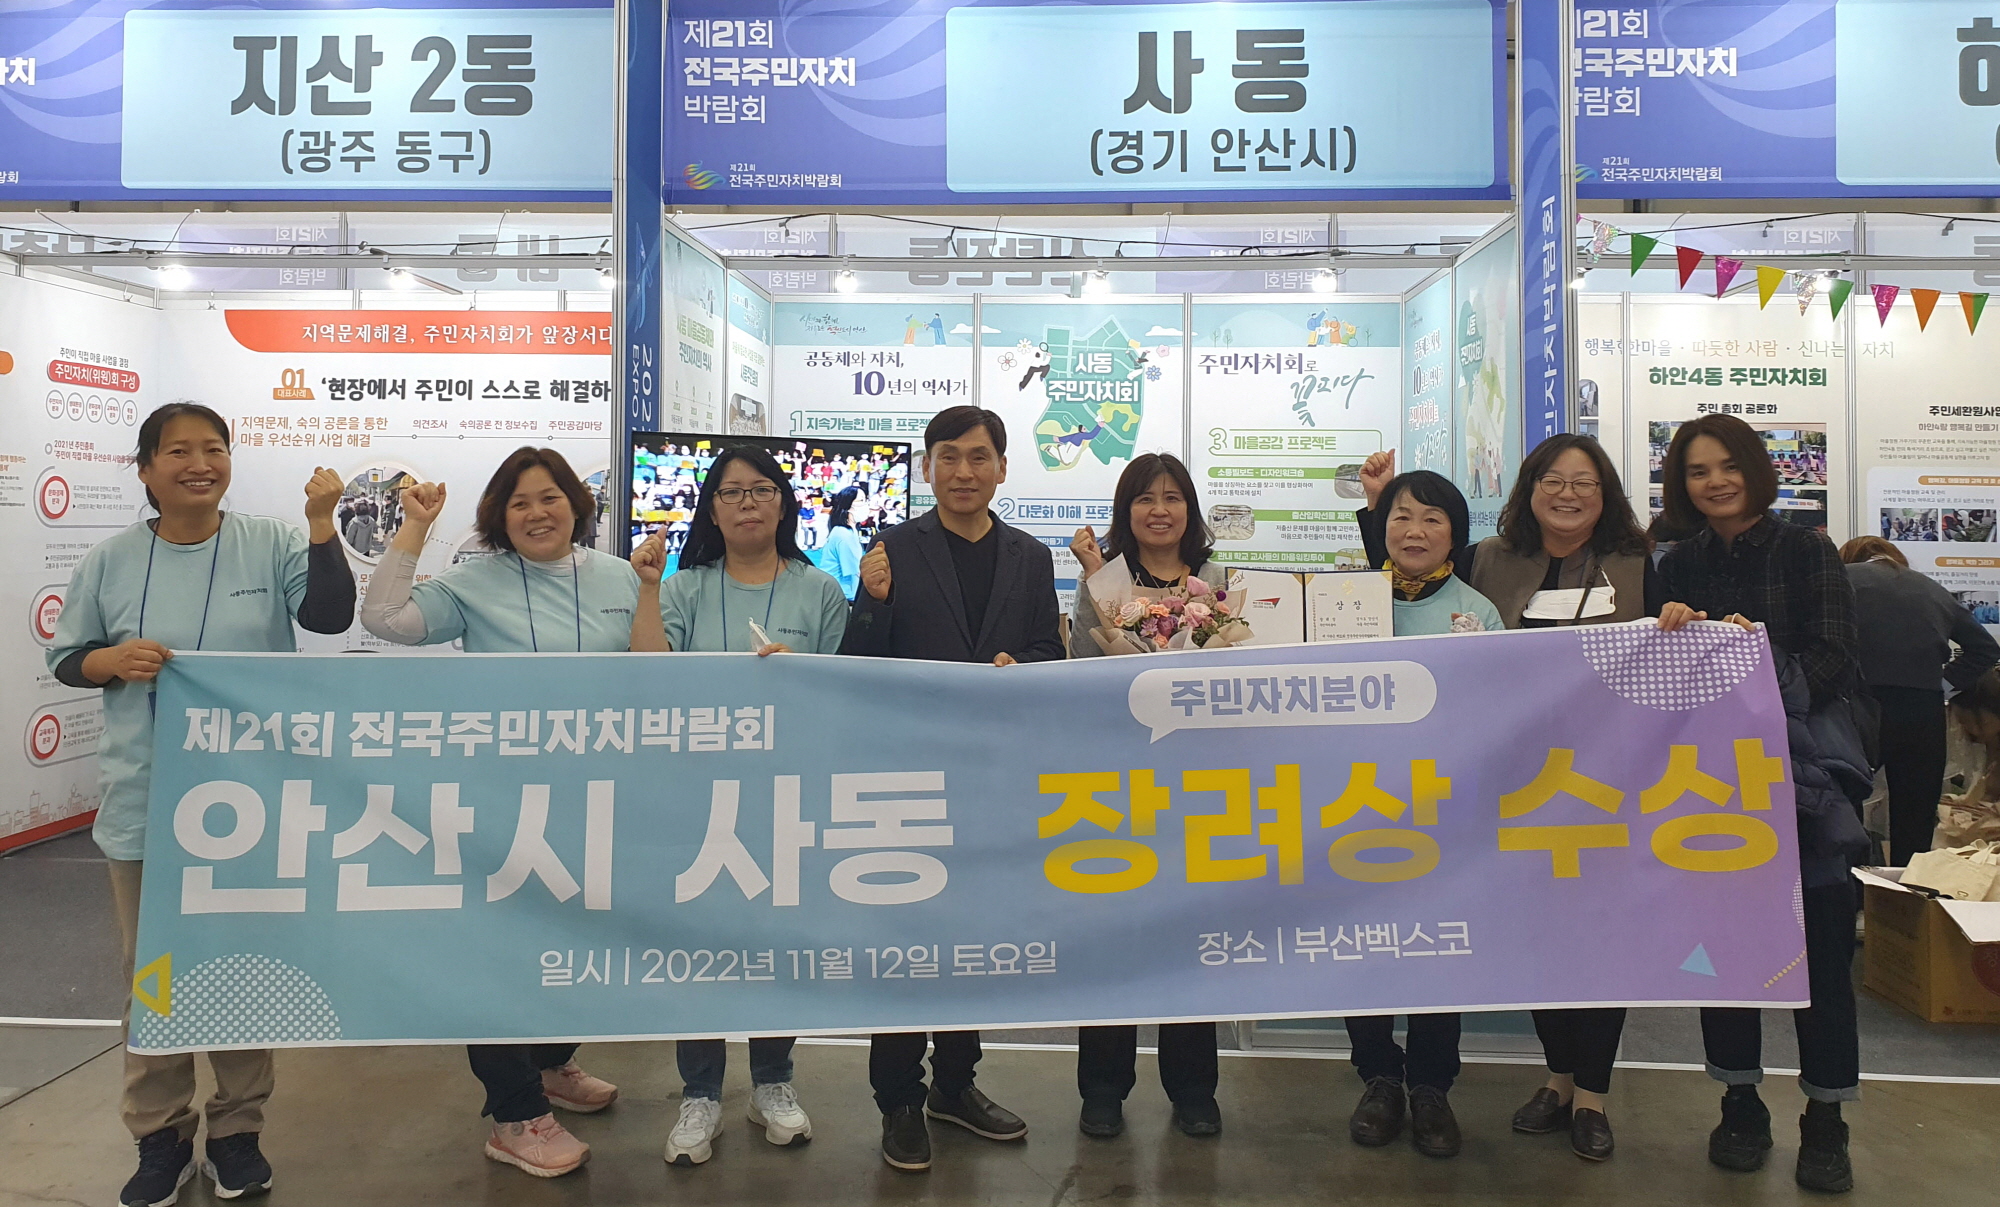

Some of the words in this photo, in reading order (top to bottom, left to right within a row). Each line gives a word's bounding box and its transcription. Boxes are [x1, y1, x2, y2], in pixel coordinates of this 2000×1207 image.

[684, 20, 773, 48] 제21회
[231, 35, 382, 115] 지산
[410, 35, 536, 116] 2동
[683, 57, 856, 86] 전국주민자치
[1124, 30, 1204, 114] 사
[1232, 29, 1309, 113] 동
[684, 95, 766, 123] 박람회
[281, 129, 374, 174] (광주
[395, 129, 491, 174] 동구)
[1091, 128, 1188, 176] (경기
[1211, 126, 1356, 173] 안산시)
[1602, 157, 1630, 166] 제21회
[730, 163, 756, 172] 제21회
[1601, 167, 1722, 182] 전국주민자치박람회
[729, 174, 842, 188] 전국주민자치박람회
[302, 324, 415, 344] 지역문제해결,
[424, 325, 533, 345] 주민자치회가
[1692, 339, 1741, 358] 따듯한
[1745, 340, 1778, 358] 사람
[1798, 339, 1845, 358] 신나는
[1862, 341, 1895, 358] 자치
[804, 351, 866, 368] 공동체와
[870, 351, 904, 368] 자치,
[1075, 352, 1112, 374] 사동
[1198, 353, 1319, 374] 주민자치회로
[55, 363, 119, 387] 주민자치(위원)회
[120, 373, 136, 390] 구성
[281, 368, 305, 389] 01
[632, 345, 640, 417] EXPO
[921, 378, 968, 396] 역사가
[1648, 366, 1724, 387] 하안4동
[1729, 366, 1828, 387] 주민자치회
[277, 388, 307, 398] 대표사례
[414, 379, 473, 401] 주민이
[482, 379, 541, 400] 스스로
[550, 379, 611, 404] 해결하
[642, 344, 653, 431] 202
[1048, 380, 1139, 402] 주민자치회
[1697, 403, 1718, 415] 주민
[1721, 403, 1742, 415] 총회
[1745, 403, 1778, 415] 공론화
[241, 416, 293, 430] 지역문제,
[296, 417, 320, 430] 숙의
[324, 417, 360, 430] 공론을
[363, 416, 388, 430] 통한
[413, 419, 448, 429] 의견조사
[459, 420, 493, 430] 숙의공론
[494, 420, 503, 430] 전
[504, 420, 538, 430] 정보수집
[548, 420, 603, 431] 주민공감마당
[806, 416, 865, 431] 지속가능한
[868, 417, 893, 431] 마을
[240, 433, 264, 446] 마을
[268, 433, 315, 446] 우선순위
[319, 434, 343, 447] 사업
[347, 433, 371, 447] 해결
[1234, 436, 1284, 450] 마을공감
[1287, 436, 1337, 450] 프로젝트
[1018, 505, 1054, 519] 다문화
[1057, 505, 1081, 519] 이해
[1169, 674, 1396, 717] 주민자치분야
[184, 708, 333, 757] 제21회
[348, 705, 775, 758] 전국주민자치박람회
[173, 779, 615, 915] 안산시
[675, 771, 953, 906] 사동
[1037, 758, 1451, 894] 장려상
[1497, 737, 1785, 878] 수상
[539, 949, 610, 986] 일시
[640, 947, 775, 984] 2022년
[785, 945, 854, 981] 11월
[865, 943, 940, 980] 12일
[951, 940, 1057, 977] 토요일
[1198, 929, 1268, 967] 장소
[1294, 921, 1473, 965] 부산벡스코
